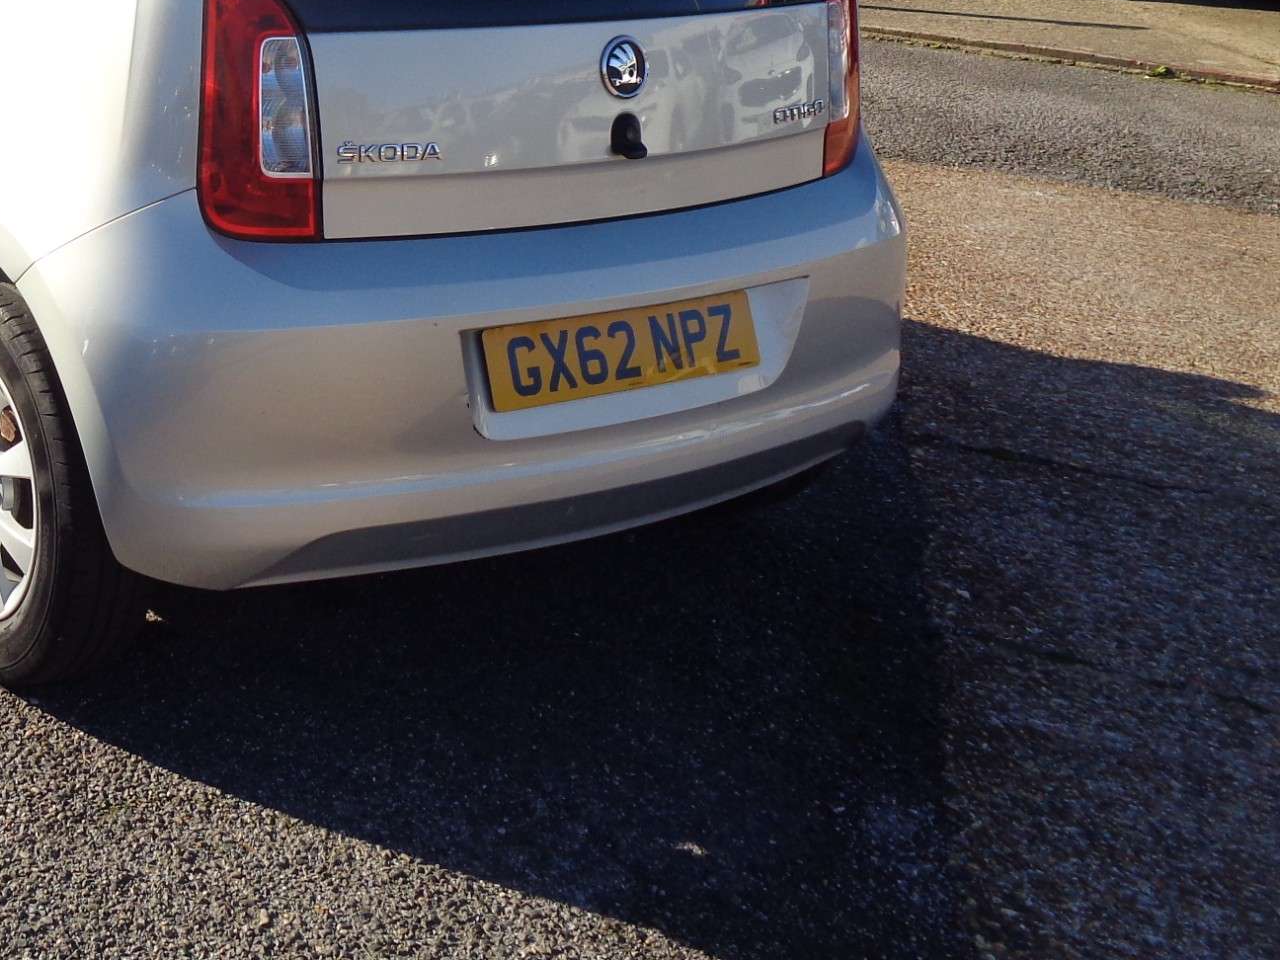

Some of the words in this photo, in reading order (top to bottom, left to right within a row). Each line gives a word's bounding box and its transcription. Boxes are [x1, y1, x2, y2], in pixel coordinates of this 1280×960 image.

[336, 140, 441, 164] ŠKODA
[507, 320, 642, 397] GX62
[648, 303, 741, 373] NPZ
